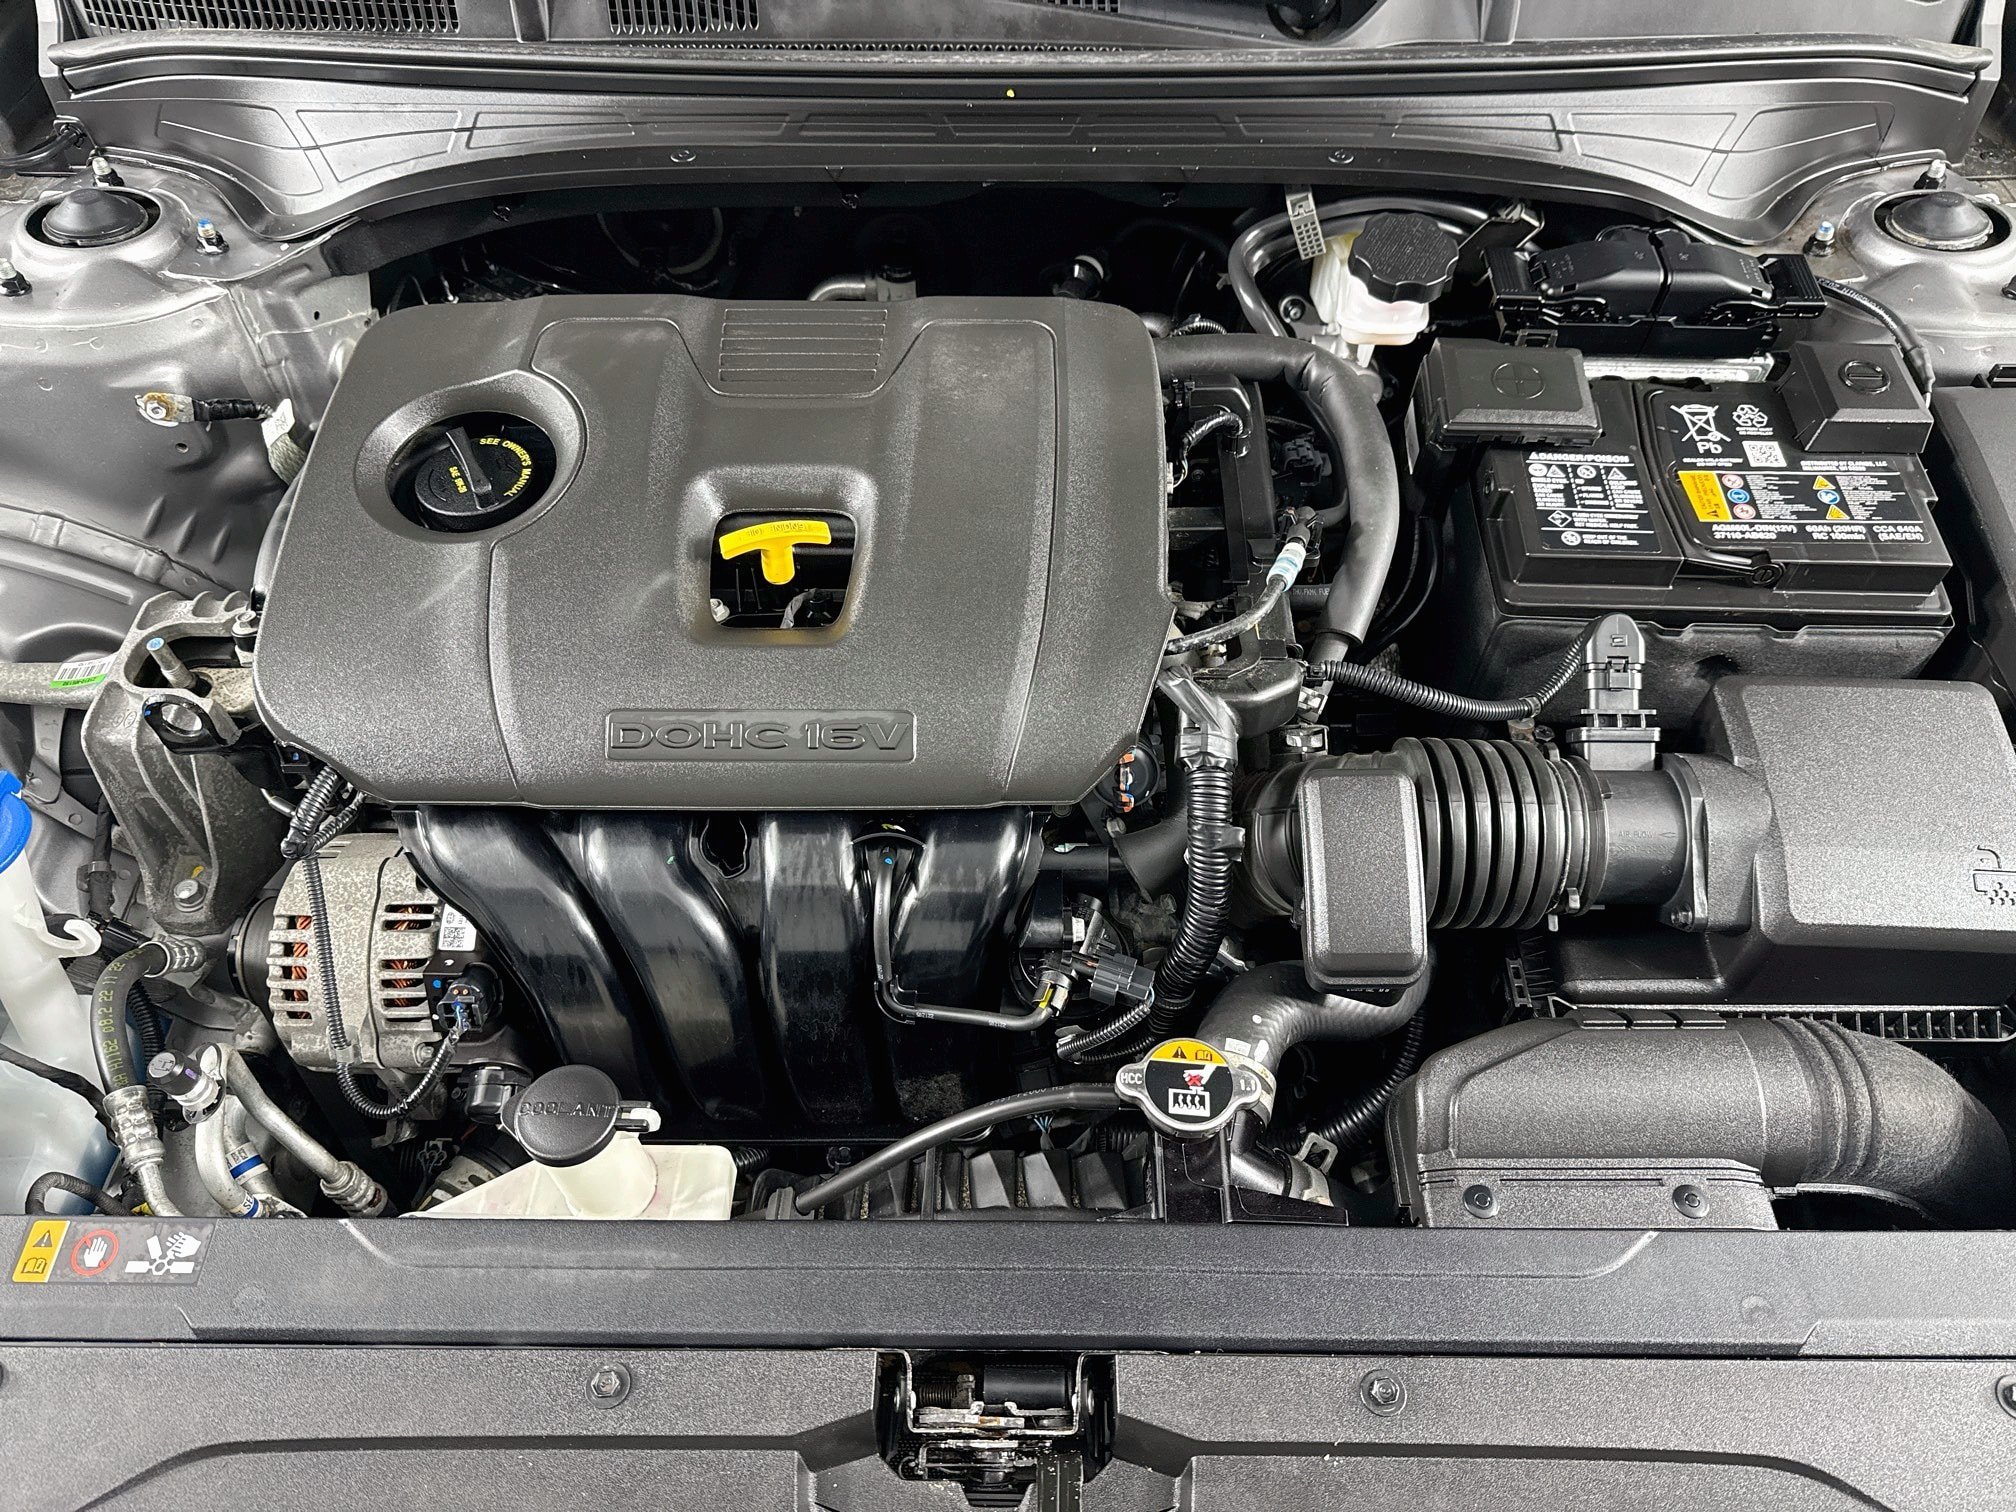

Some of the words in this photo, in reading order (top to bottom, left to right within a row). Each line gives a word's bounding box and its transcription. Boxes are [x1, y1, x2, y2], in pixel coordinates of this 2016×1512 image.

[479, 437, 501, 446] SEE
[1696, 442, 1723, 454] Pb
[502, 440, 532, 467] OWNER'S
[503, 468, 532, 497] MANUAL
[609, 722, 790, 750] DOHC
[803, 722, 909, 750] 16V
[1120, 1072, 1143, 1084] HCC
[1239, 1079, 1257, 1091] 1.1
[518, 1101, 616, 1118] COOLANT
